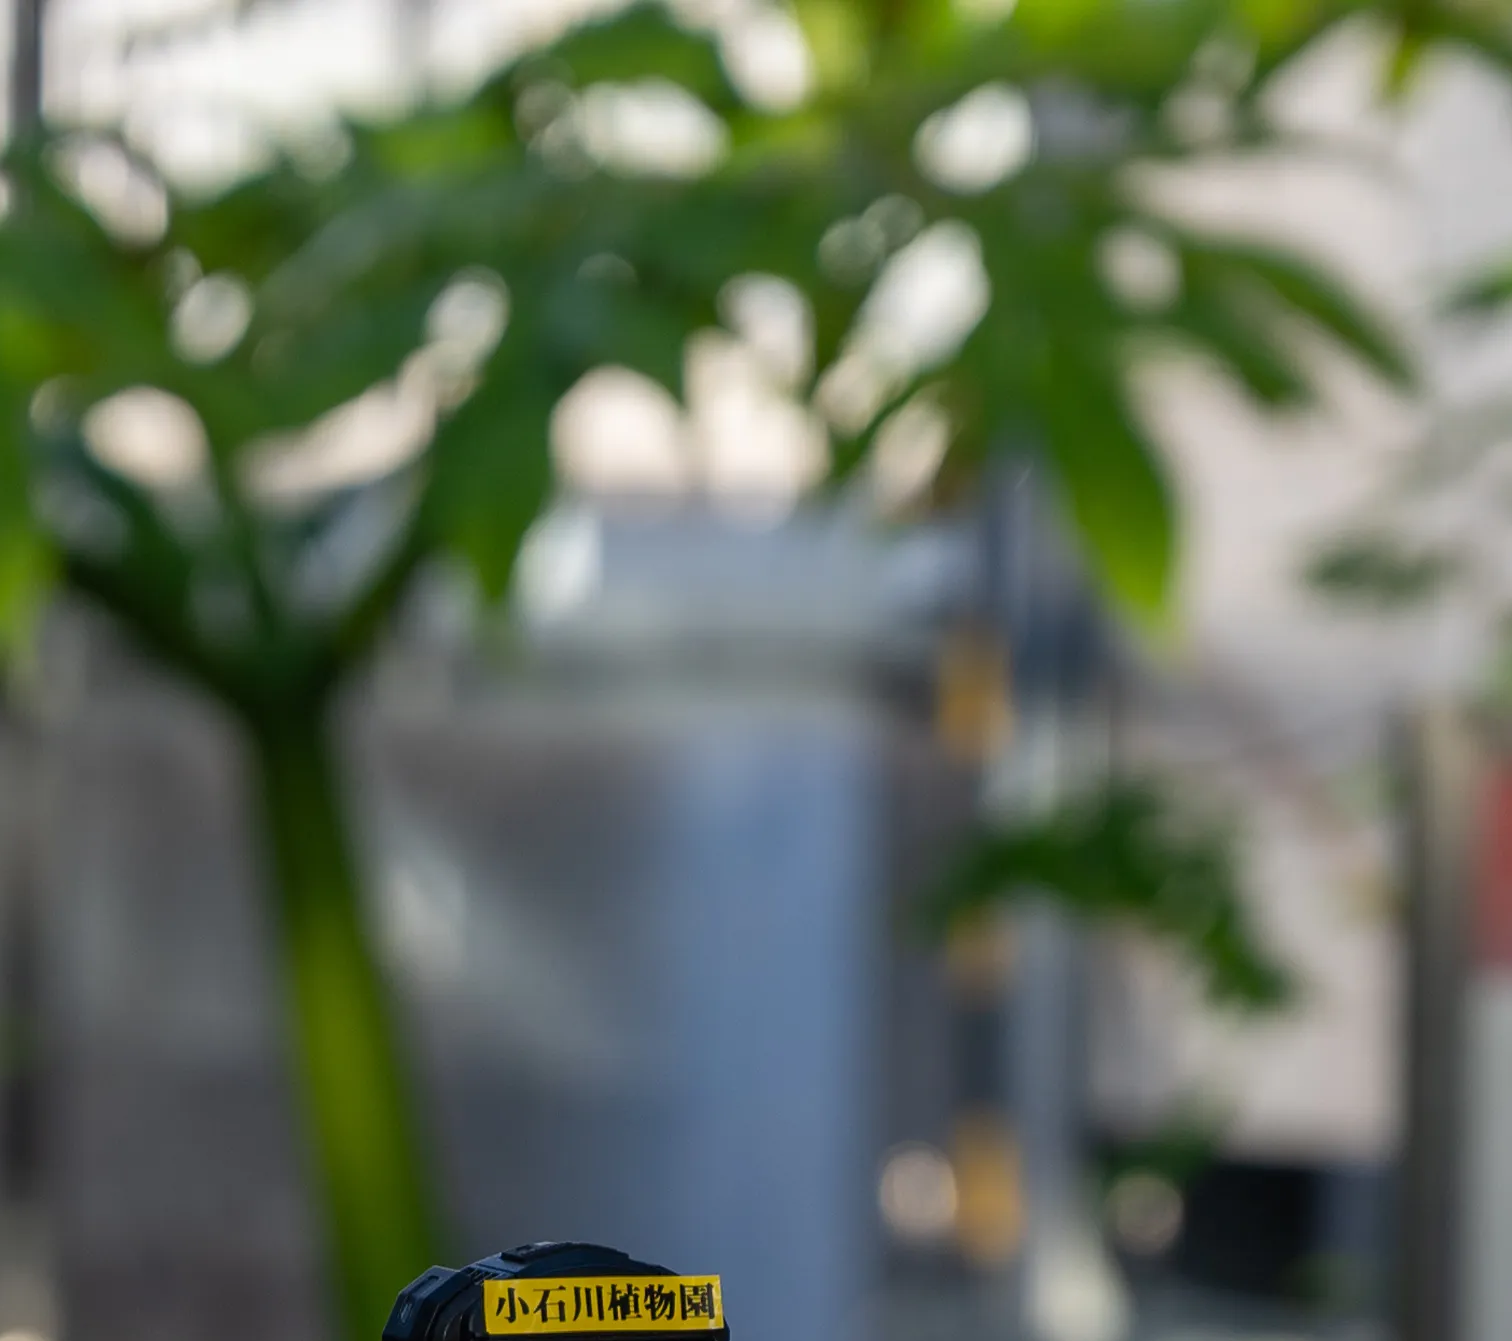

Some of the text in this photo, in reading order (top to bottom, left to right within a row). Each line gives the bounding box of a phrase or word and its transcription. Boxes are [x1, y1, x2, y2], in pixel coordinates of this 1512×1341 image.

[495, 1283, 715, 1323] 小石川植物園
